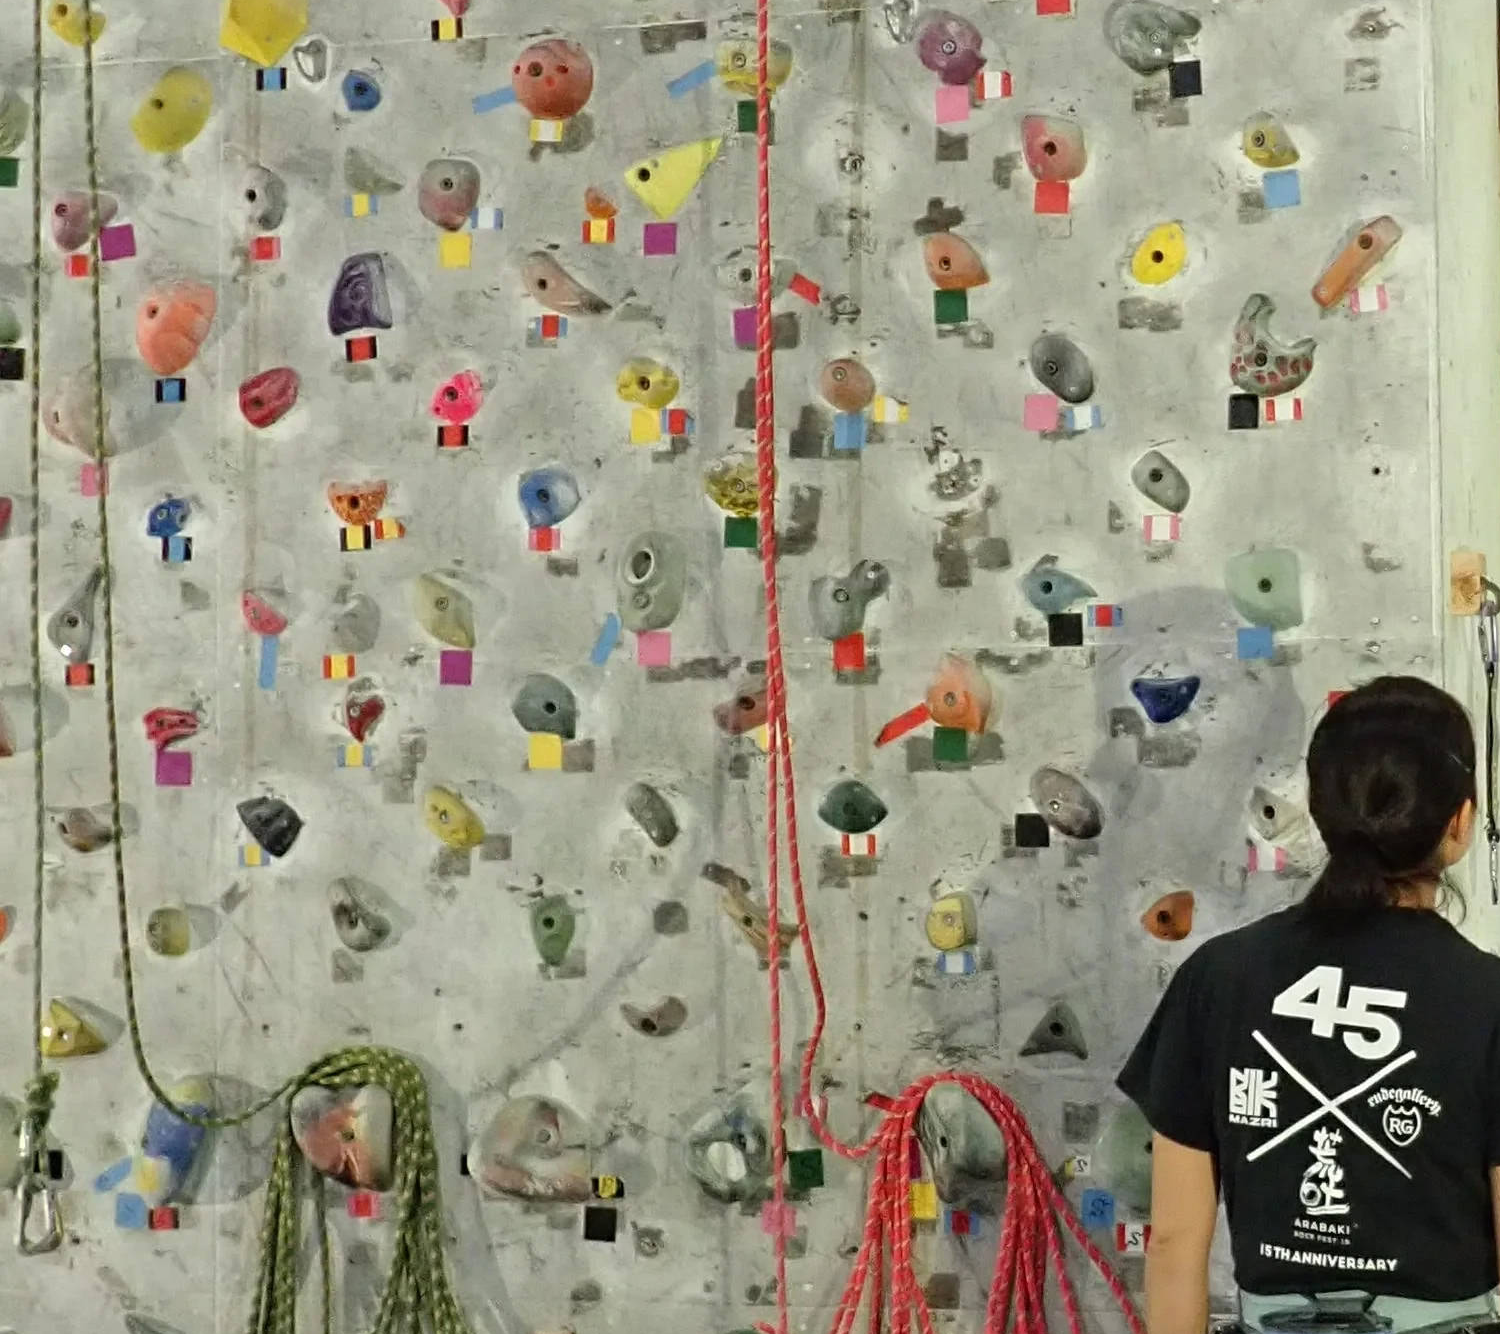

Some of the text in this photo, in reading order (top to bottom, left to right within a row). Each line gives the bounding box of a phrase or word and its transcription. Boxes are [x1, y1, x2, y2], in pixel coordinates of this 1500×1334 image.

[1272, 965, 1407, 1060] 45
[1389, 1117, 1415, 1136] RG
[1294, 1217, 1351, 1235] ARABAKI
